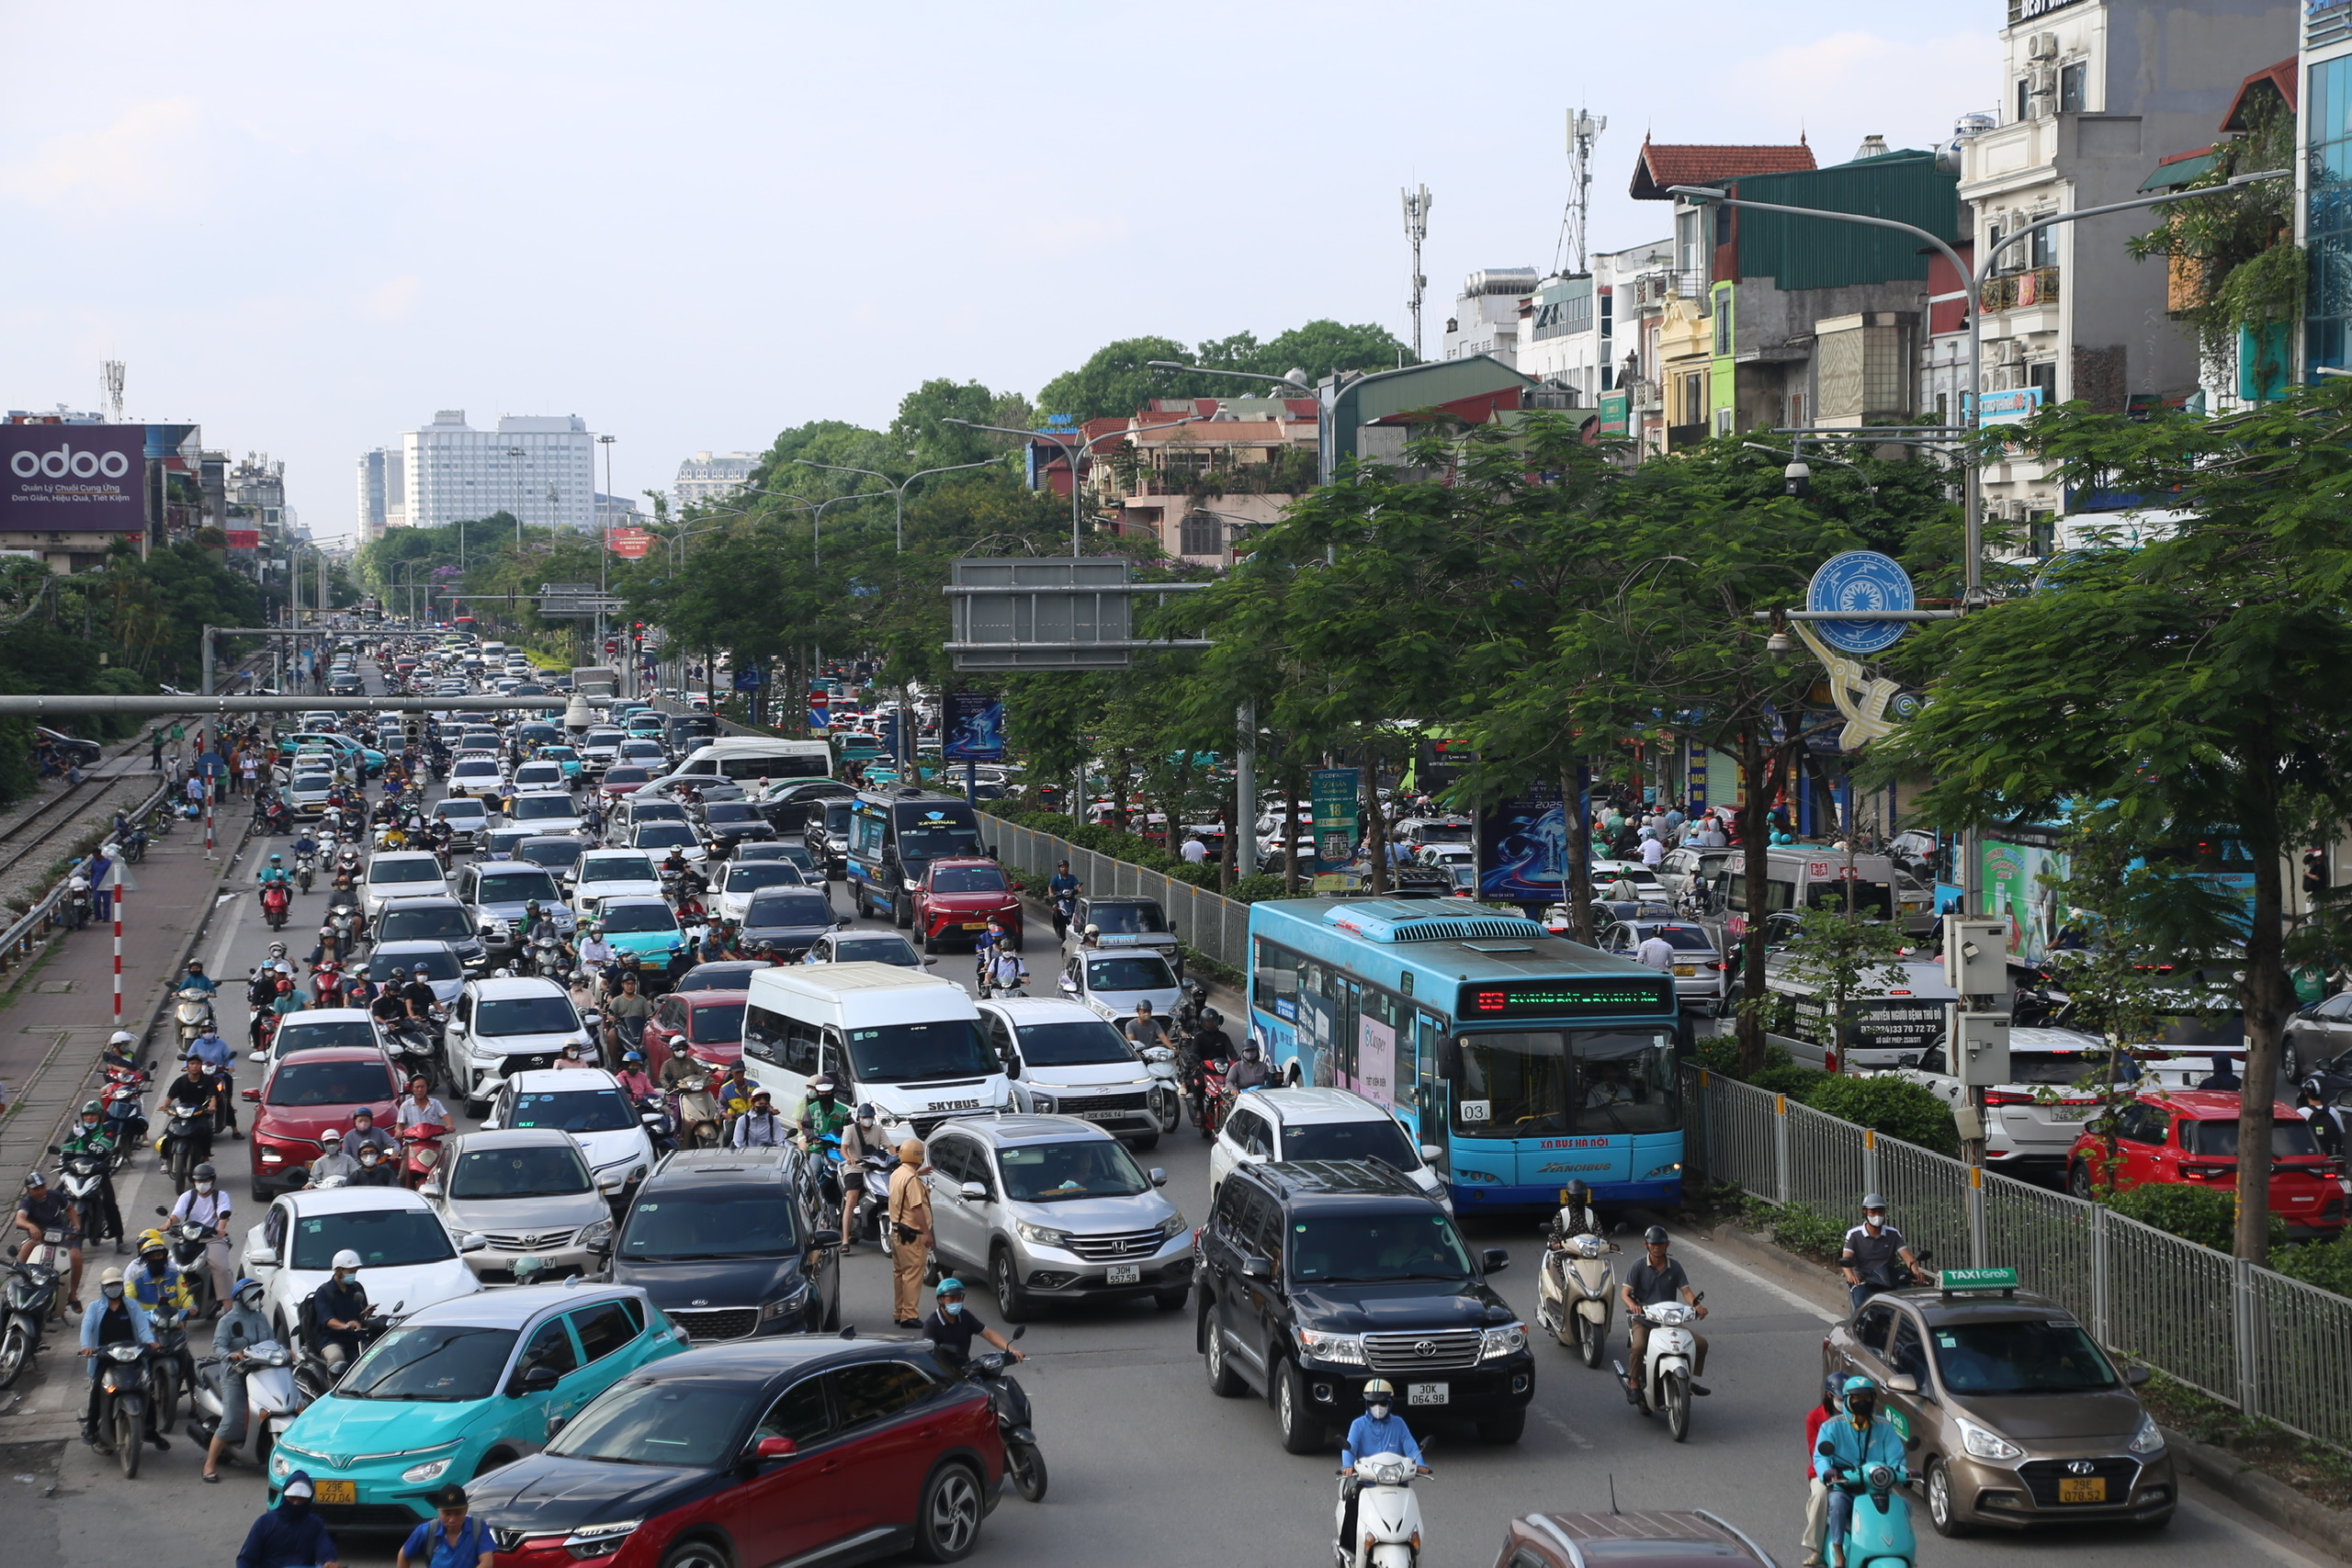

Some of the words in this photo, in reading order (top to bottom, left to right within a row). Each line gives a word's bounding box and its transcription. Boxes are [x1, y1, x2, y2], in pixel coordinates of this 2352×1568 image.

[10, 443, 129, 479] odoo
[21, 483, 42, 492] Quản
[44, 483, 53, 493] Lý
[80, 484, 101, 493] Cung
[1329, 803, 1341, 817] 18
[1535, 801, 1564, 809] 2025
[1908, 1008, 1923, 1022] BỆNH
[1915, 1024, 1925, 1032] 72
[1926, 1024, 1937, 1032] 72
[927, 1100, 980, 1111] SKYBUS
[1555, 1139, 1572, 1148] BUS
[1575, 1137, 1588, 1147] HÀ
[1535, 1161, 1611, 1174] HANOIBUS
[1116, 1266, 1131, 1274] 30H
[1948, 1270, 1981, 1280] TAXI
[1982, 1269, 2009, 1279] Grab
[1110, 1273, 1136, 1283] 557.58
[362, 1347, 381, 1362] TAXI
[1419, 1384, 1437, 1393] 30K
[1412, 1394, 1444, 1404] 064.98
[1892, 1414, 1904, 1429] Grab
[325, 1483, 344, 1493] 29E
[2073, 1480, 2093, 1490] 29E
[319, 1493, 351, 1504] 327.04
[2064, 1490, 2101, 1501] 078.52
